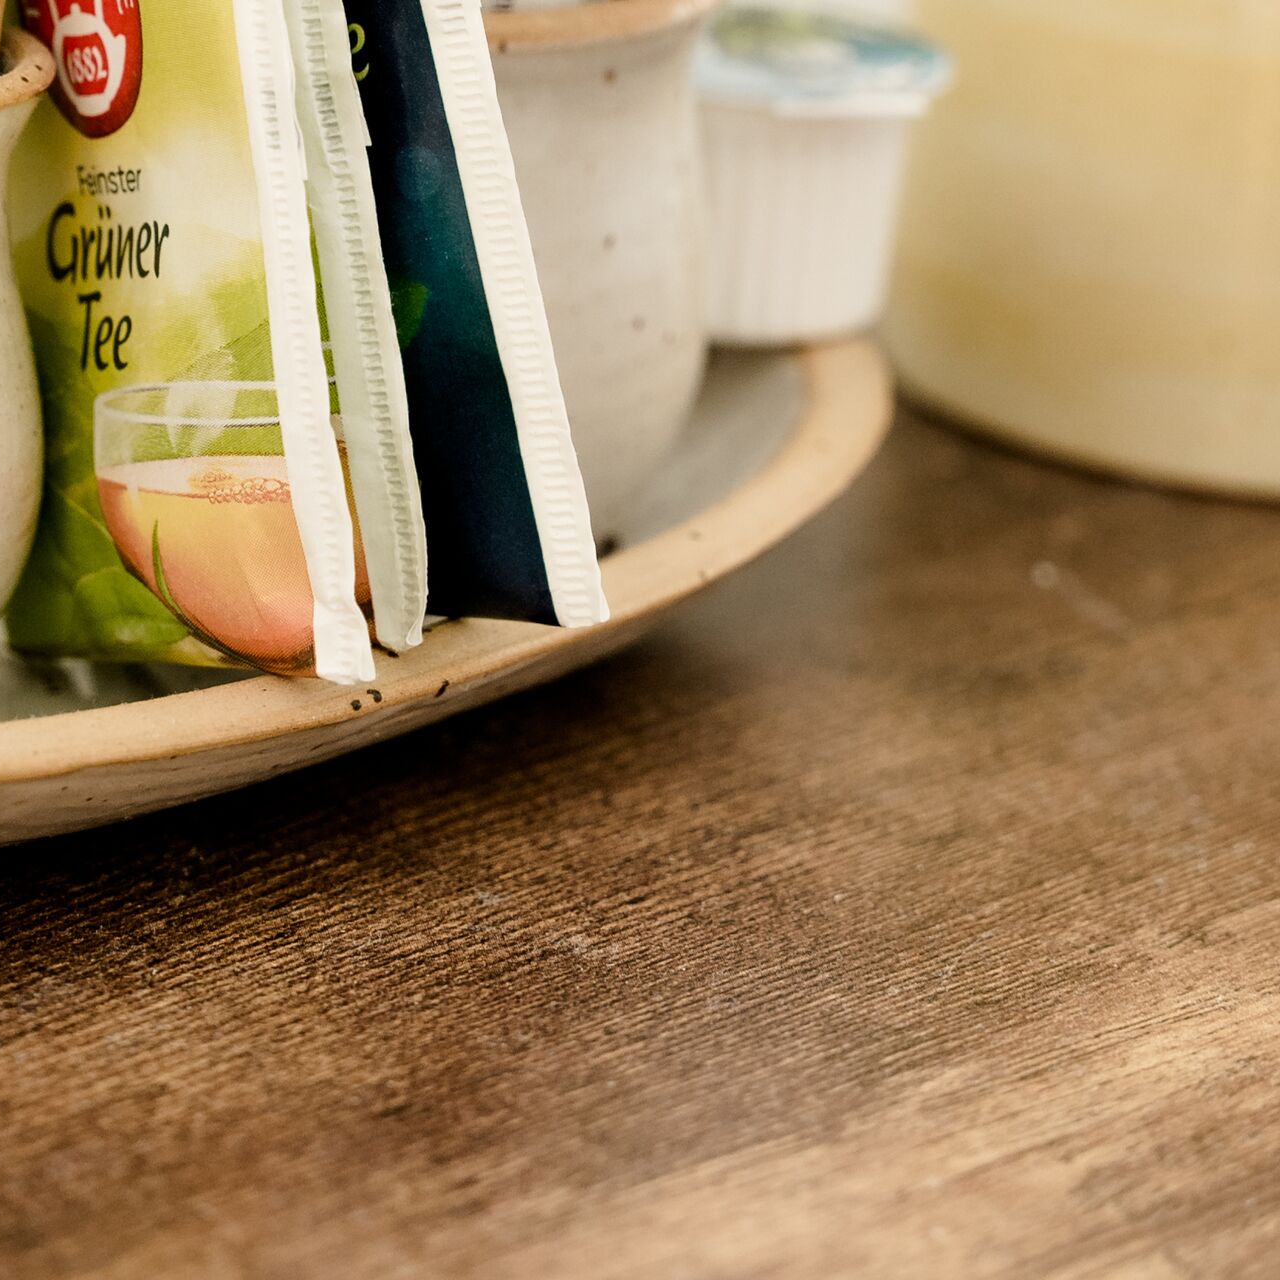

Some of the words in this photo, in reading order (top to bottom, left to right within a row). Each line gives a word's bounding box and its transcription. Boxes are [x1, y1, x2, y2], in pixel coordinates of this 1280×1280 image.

[67, 45, 107, 84] 1882
[76, 165, 142, 196] Feinster
[46, 200, 170, 284] Grüner
[77, 291, 132, 371] Tee
